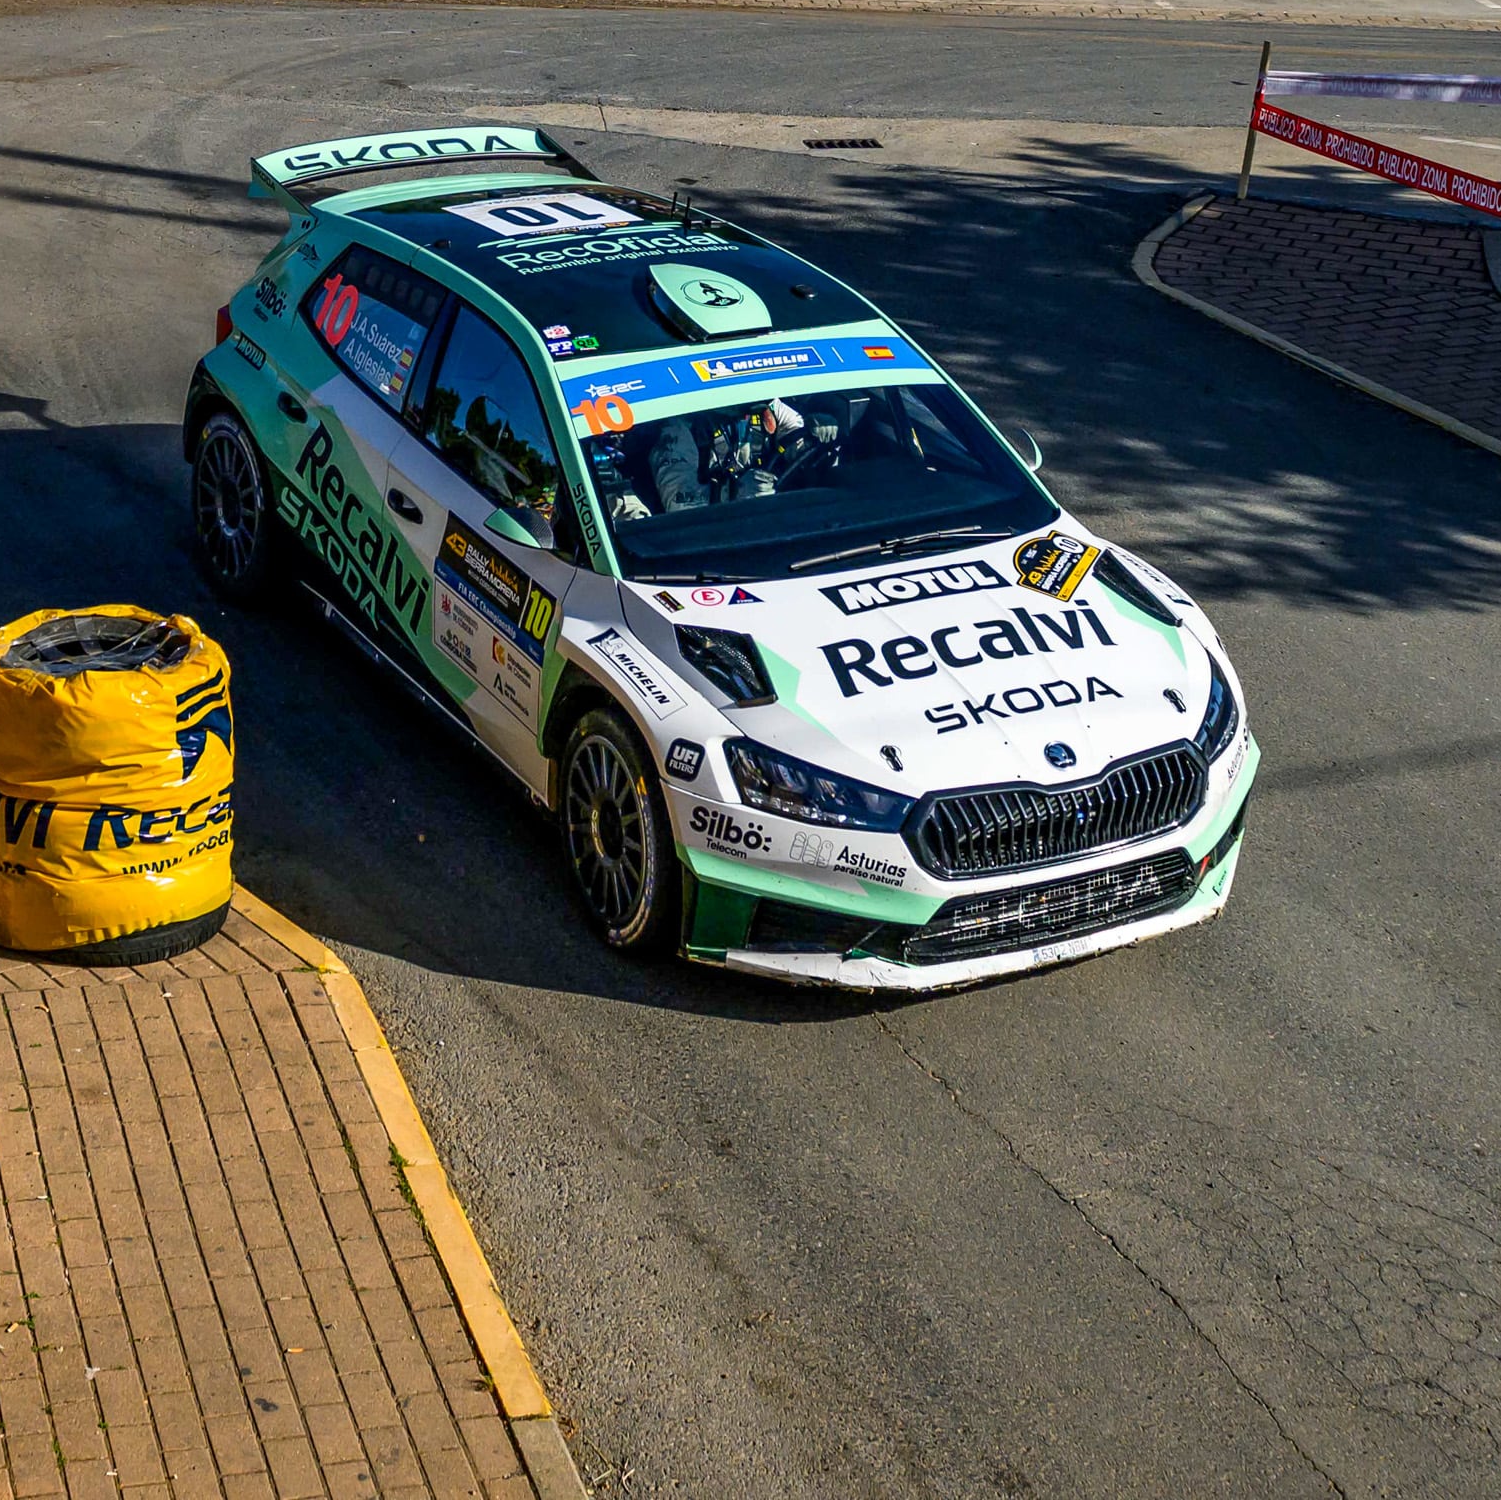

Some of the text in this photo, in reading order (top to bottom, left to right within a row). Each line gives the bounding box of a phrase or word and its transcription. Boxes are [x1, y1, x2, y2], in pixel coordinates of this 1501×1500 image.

[1257, 107, 1296, 139] PUBLICO
[1299, 122, 1322, 151] ZONA
[1326, 132, 1375, 169] PROHIBIDO
[1377, 151, 1418, 182] PUBLICO
[1421, 165, 1448, 194] ZONA
[496, 232, 730, 271] RecOficial
[518, 243, 740, 276] Recambio original exclusivo
[315, 273, 359, 346] 10
[236, 338, 265, 367] MOTUL
[733, 354, 809, 371] MICHELIN
[572, 395, 634, 436] 10
[295, 420, 430, 636] Recalvi
[1059, 538, 1078, 551] 10
[467, 544, 489, 566] RALLY
[846, 563, 998, 612] MOTUL
[525, 590, 552, 640] 10
[818, 599, 1118, 697] Recalvi
[615, 653, 670, 705] MICHELIN
[669, 758, 694, 775] FILTERS
[673, 745, 698, 766] UFI
[706, 838, 747, 860] Telecom
[836, 846, 908, 878] Asturias
[833, 862, 904, 888] paraíso natural
